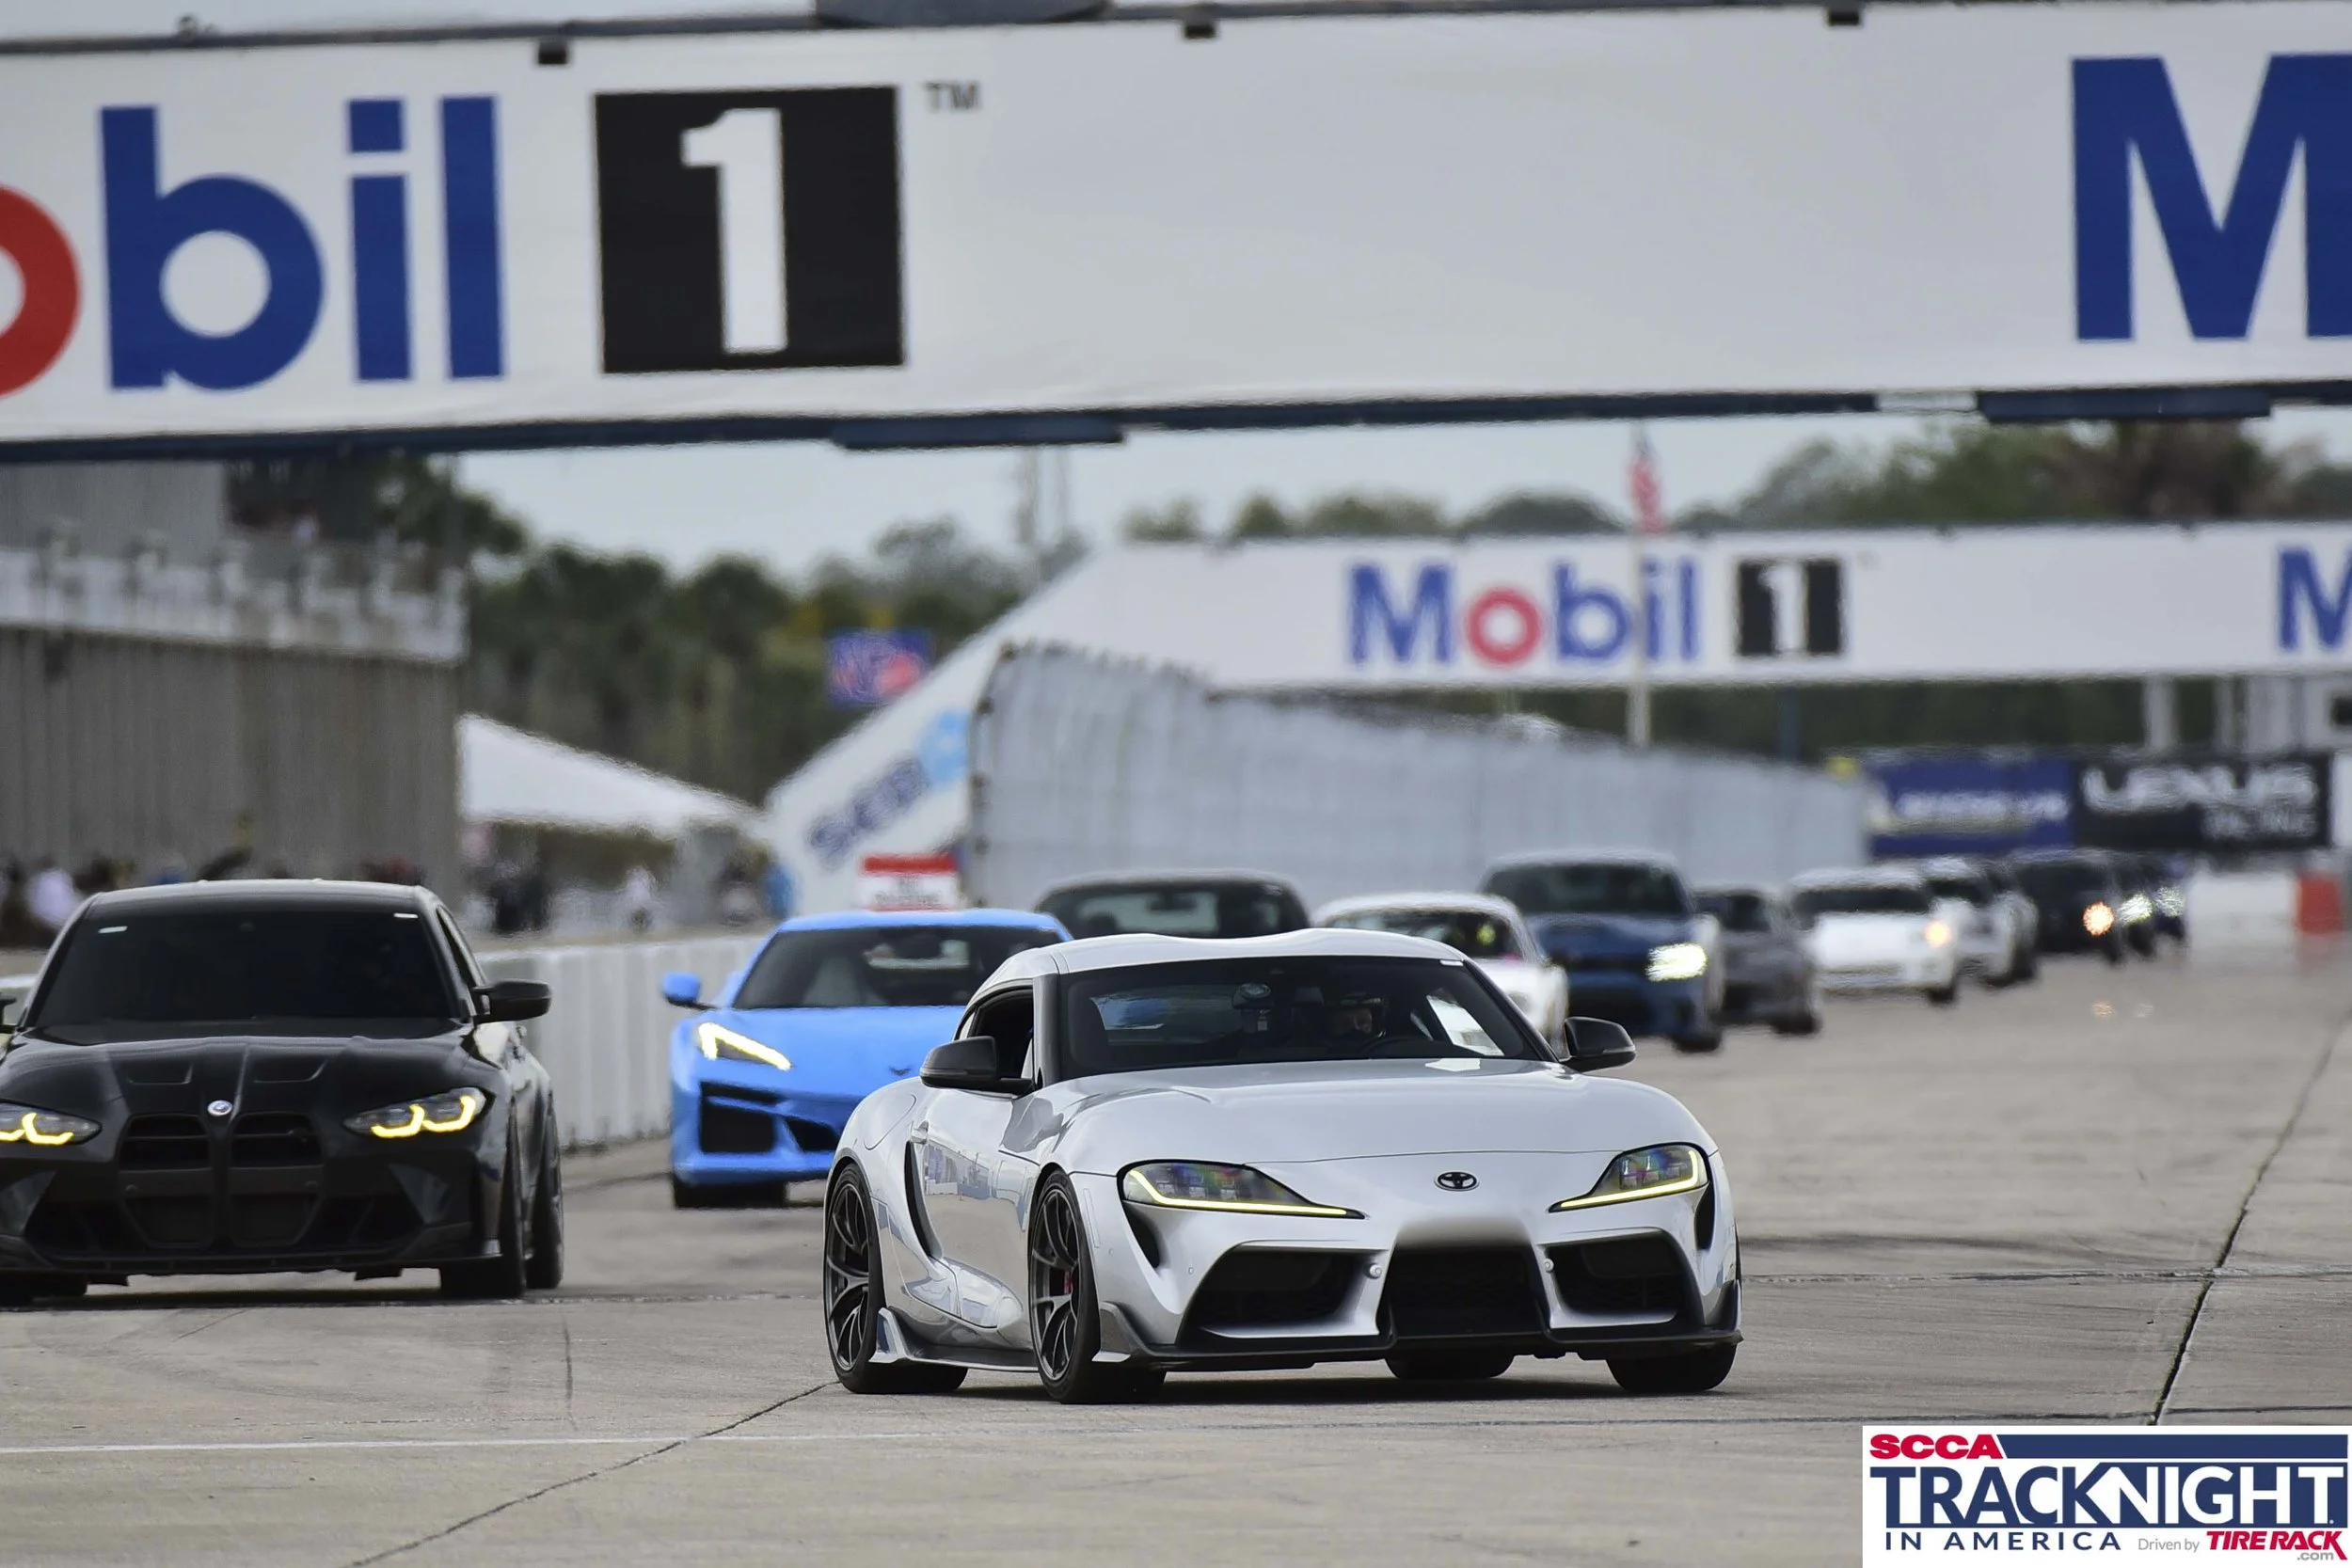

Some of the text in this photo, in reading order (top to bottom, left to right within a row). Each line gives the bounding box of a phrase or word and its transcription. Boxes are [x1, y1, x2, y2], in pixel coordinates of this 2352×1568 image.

[680, 108, 788, 355] 1
[1350, 557, 1809, 666] Mobil 1
